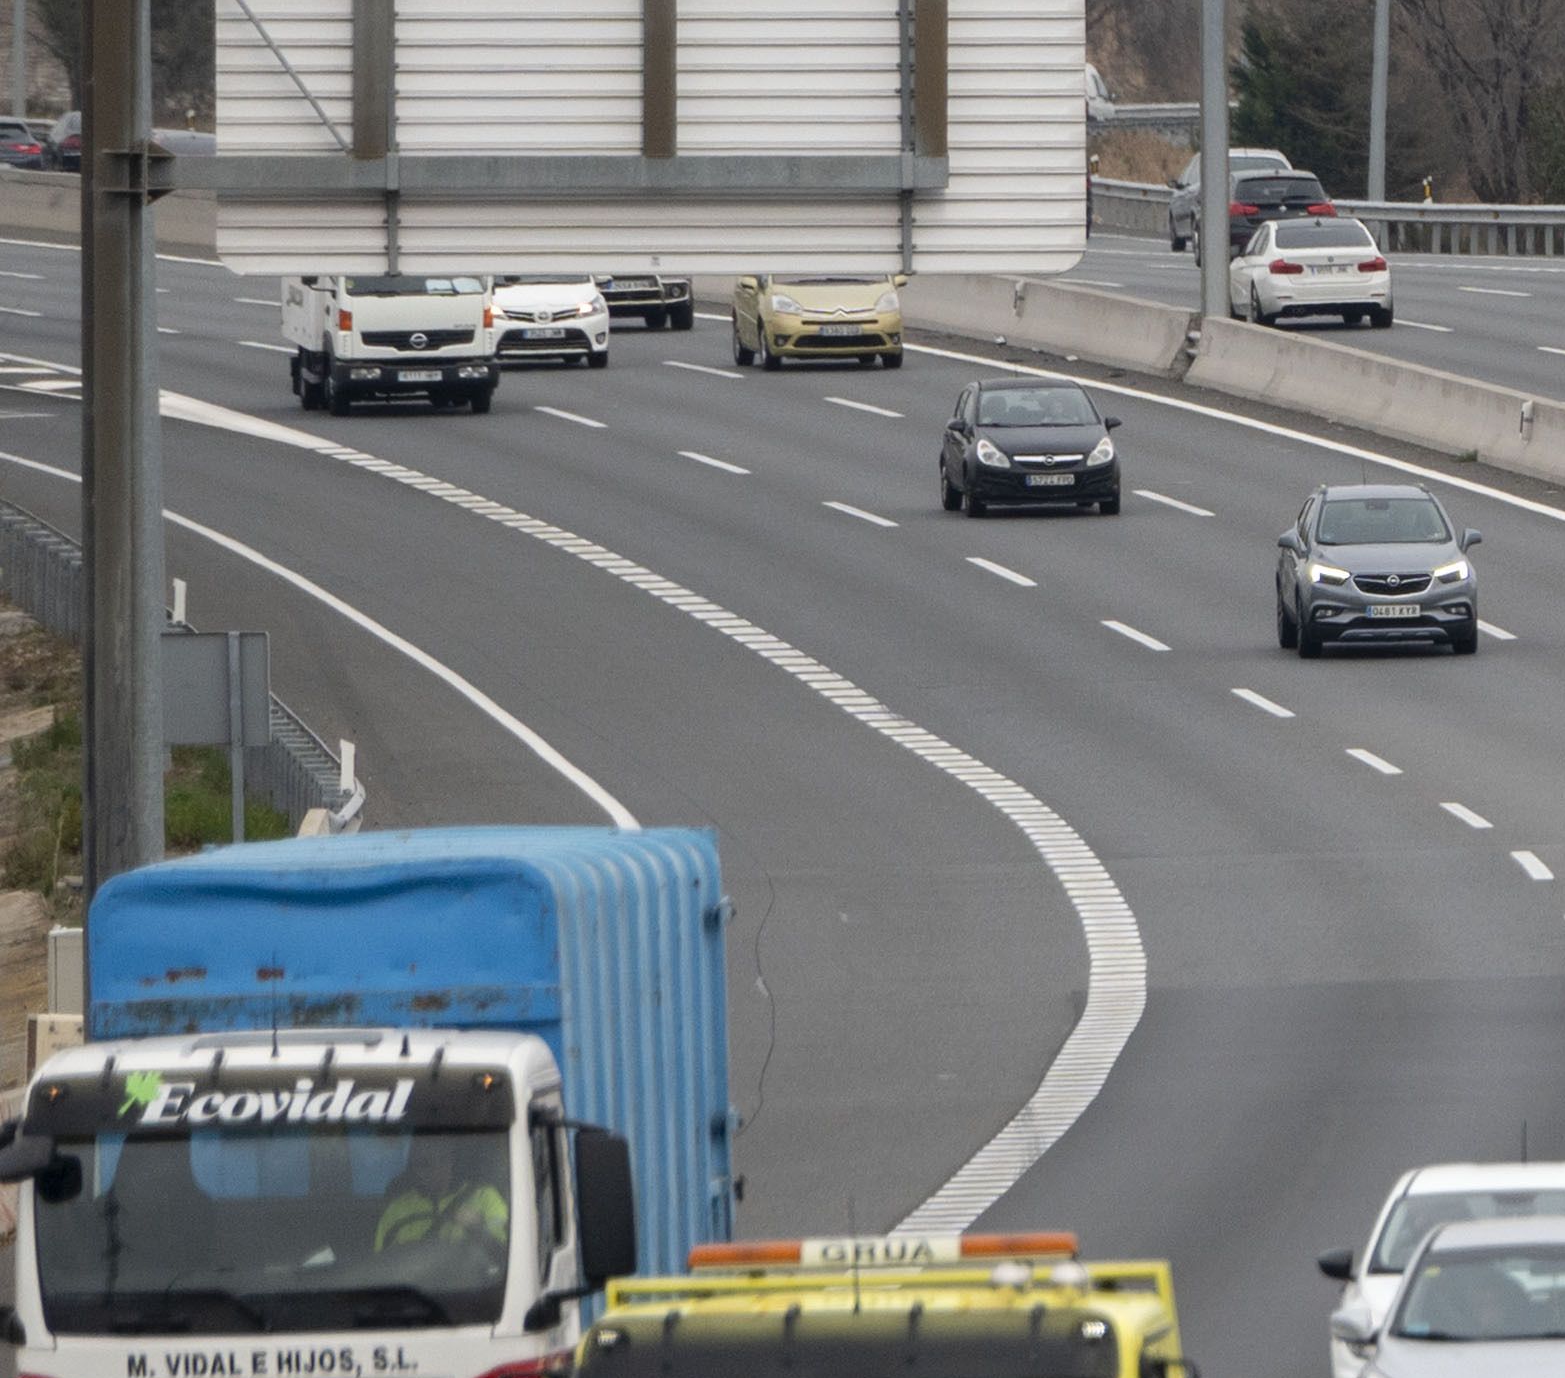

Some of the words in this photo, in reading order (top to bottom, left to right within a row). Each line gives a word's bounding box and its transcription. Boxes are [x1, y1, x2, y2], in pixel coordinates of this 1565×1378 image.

[142, 1077, 415, 1124] Ecovidal
[820, 1241, 935, 1265] GRUA
[127, 1354, 156, 1378] M.
[165, 1353, 242, 1377] VIDAL
[251, 1351, 268, 1375] E
[276, 1348, 362, 1378] HIJOS,
[373, 1346, 419, 1372] S.L.
